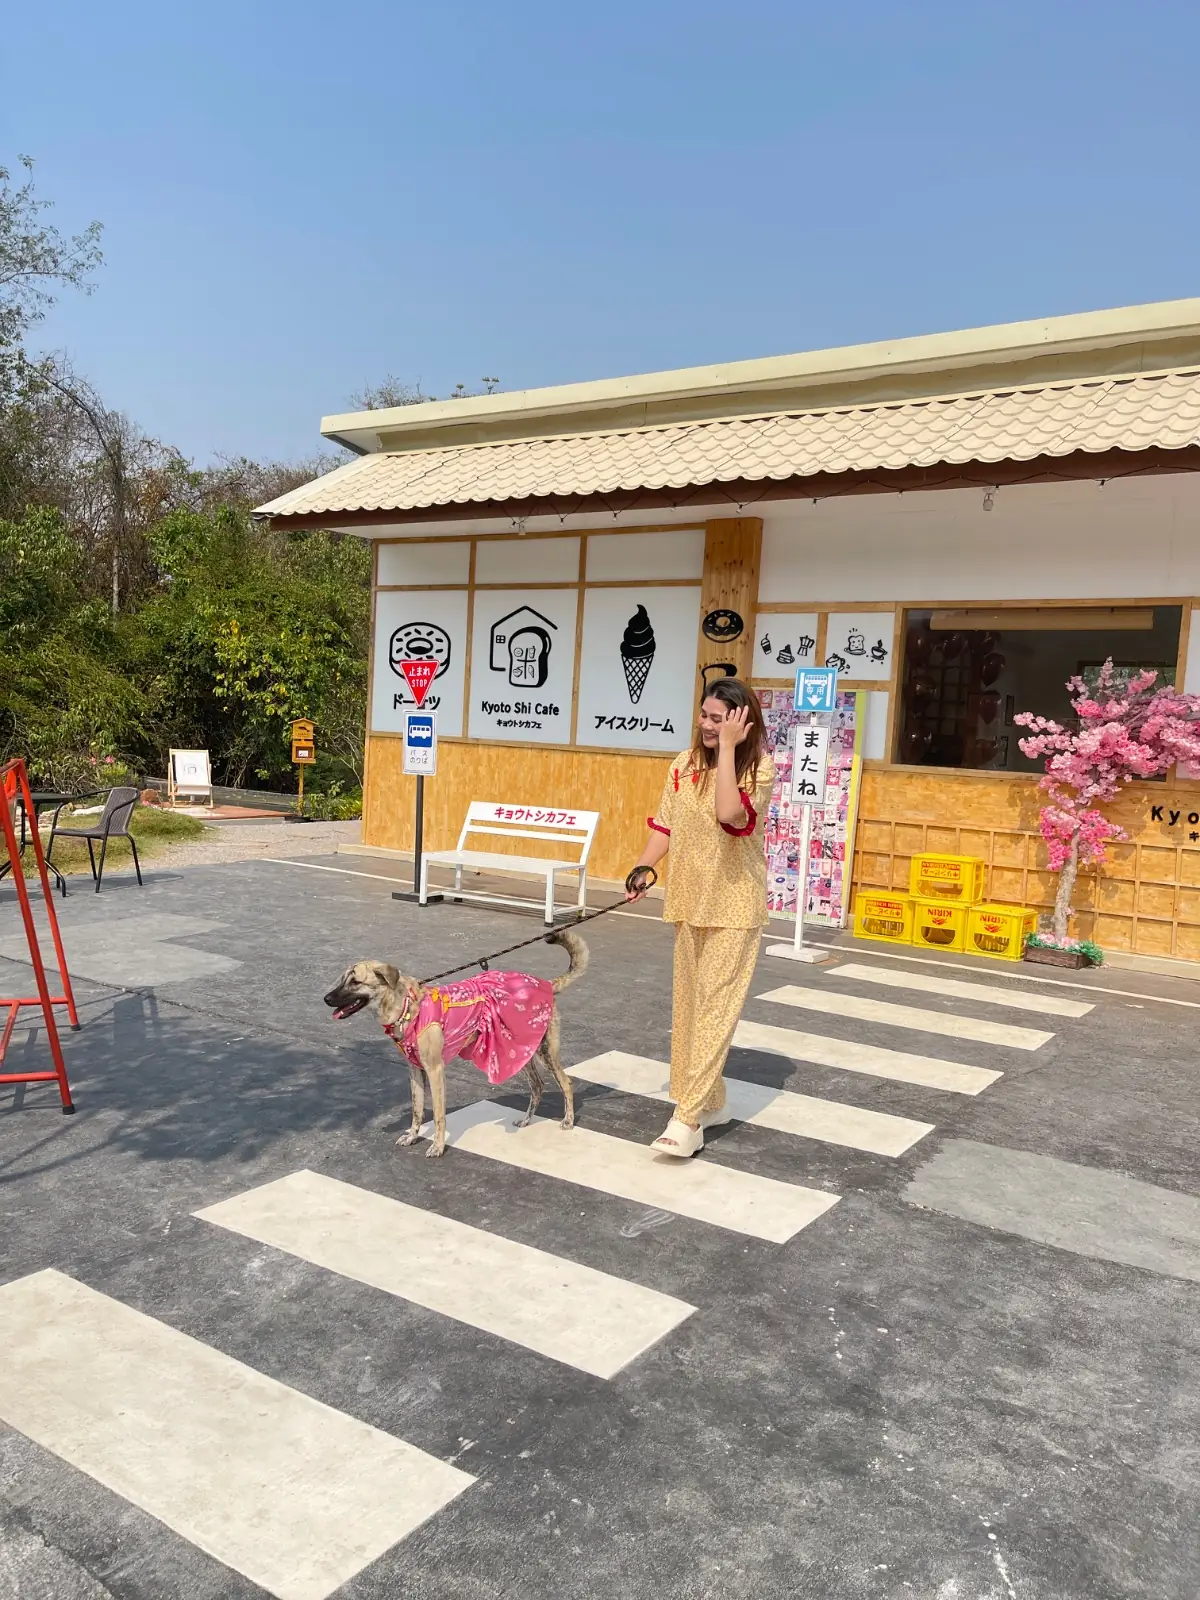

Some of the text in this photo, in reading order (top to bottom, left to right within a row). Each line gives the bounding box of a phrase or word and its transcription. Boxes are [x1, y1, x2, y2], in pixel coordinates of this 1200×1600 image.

[408, 666, 431, 677] 止まれ
[411, 679, 428, 688] STOP
[393, 693, 441, 710] ドーツ
[481, 700, 560, 716] Kyoto Shi Cafe
[496, 718, 542, 729] キョウトシカフェ
[594, 715, 675, 733] アイスクリーム
[797, 730, 820, 796] またね
[494, 806, 577, 825] キョウトシカフェ
[1151, 805, 1200, 826] Kyo
[927, 908, 953, 918] KIRIN
